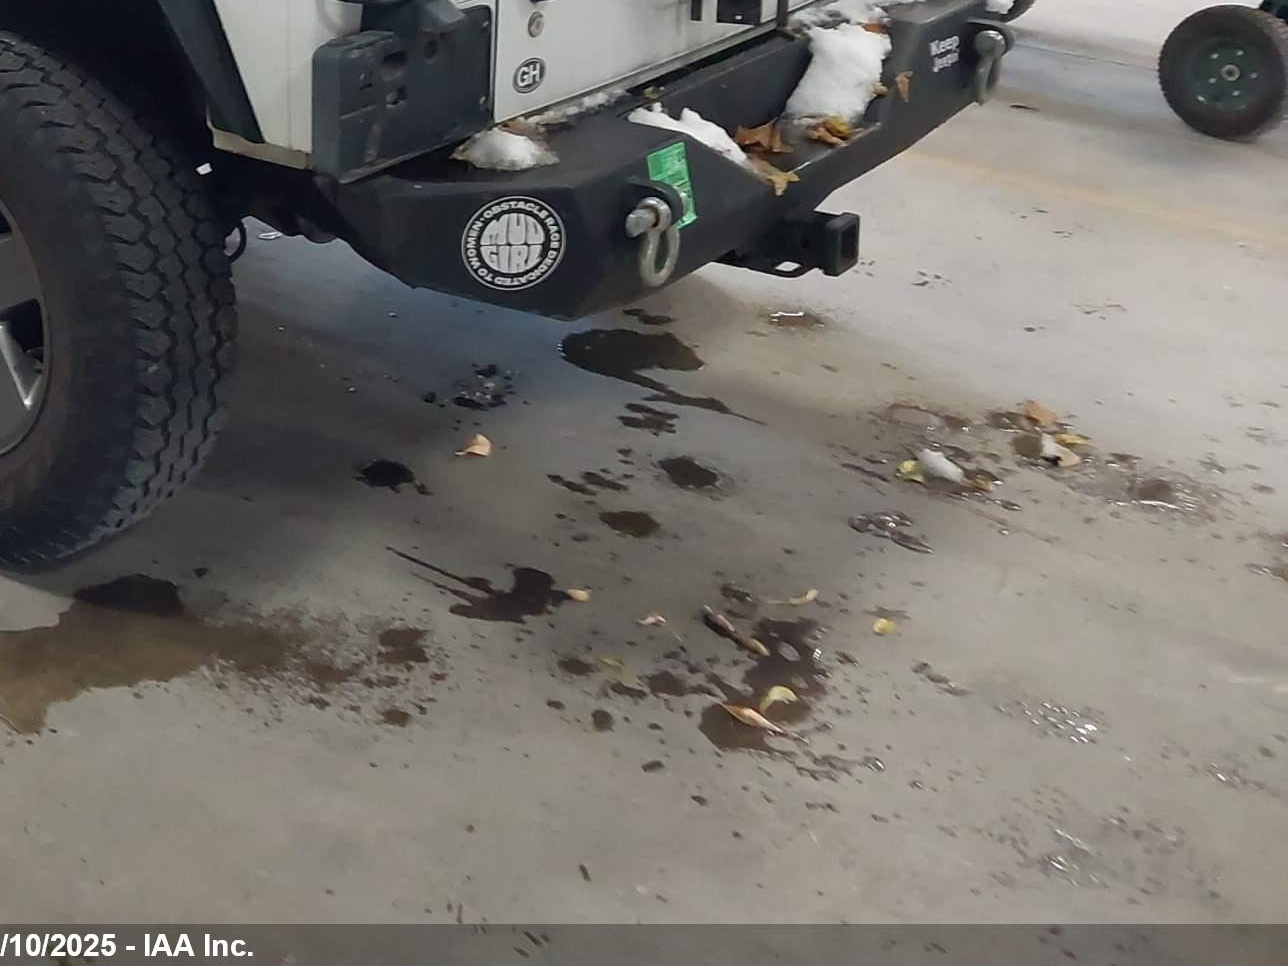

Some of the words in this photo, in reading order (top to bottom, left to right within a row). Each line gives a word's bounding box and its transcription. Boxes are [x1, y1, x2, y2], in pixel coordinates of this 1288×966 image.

[930, 35, 960, 56] Keep
[482, 200, 550, 220] OBSTACLE
[479, 212, 546, 246] MUD
[544, 216, 562, 249] RACE
[466, 220, 484, 270] WOMEN
[479, 244, 544, 274] GIRL
[476, 267, 494, 284] TO
[493, 250, 559, 287] DEDICATED
